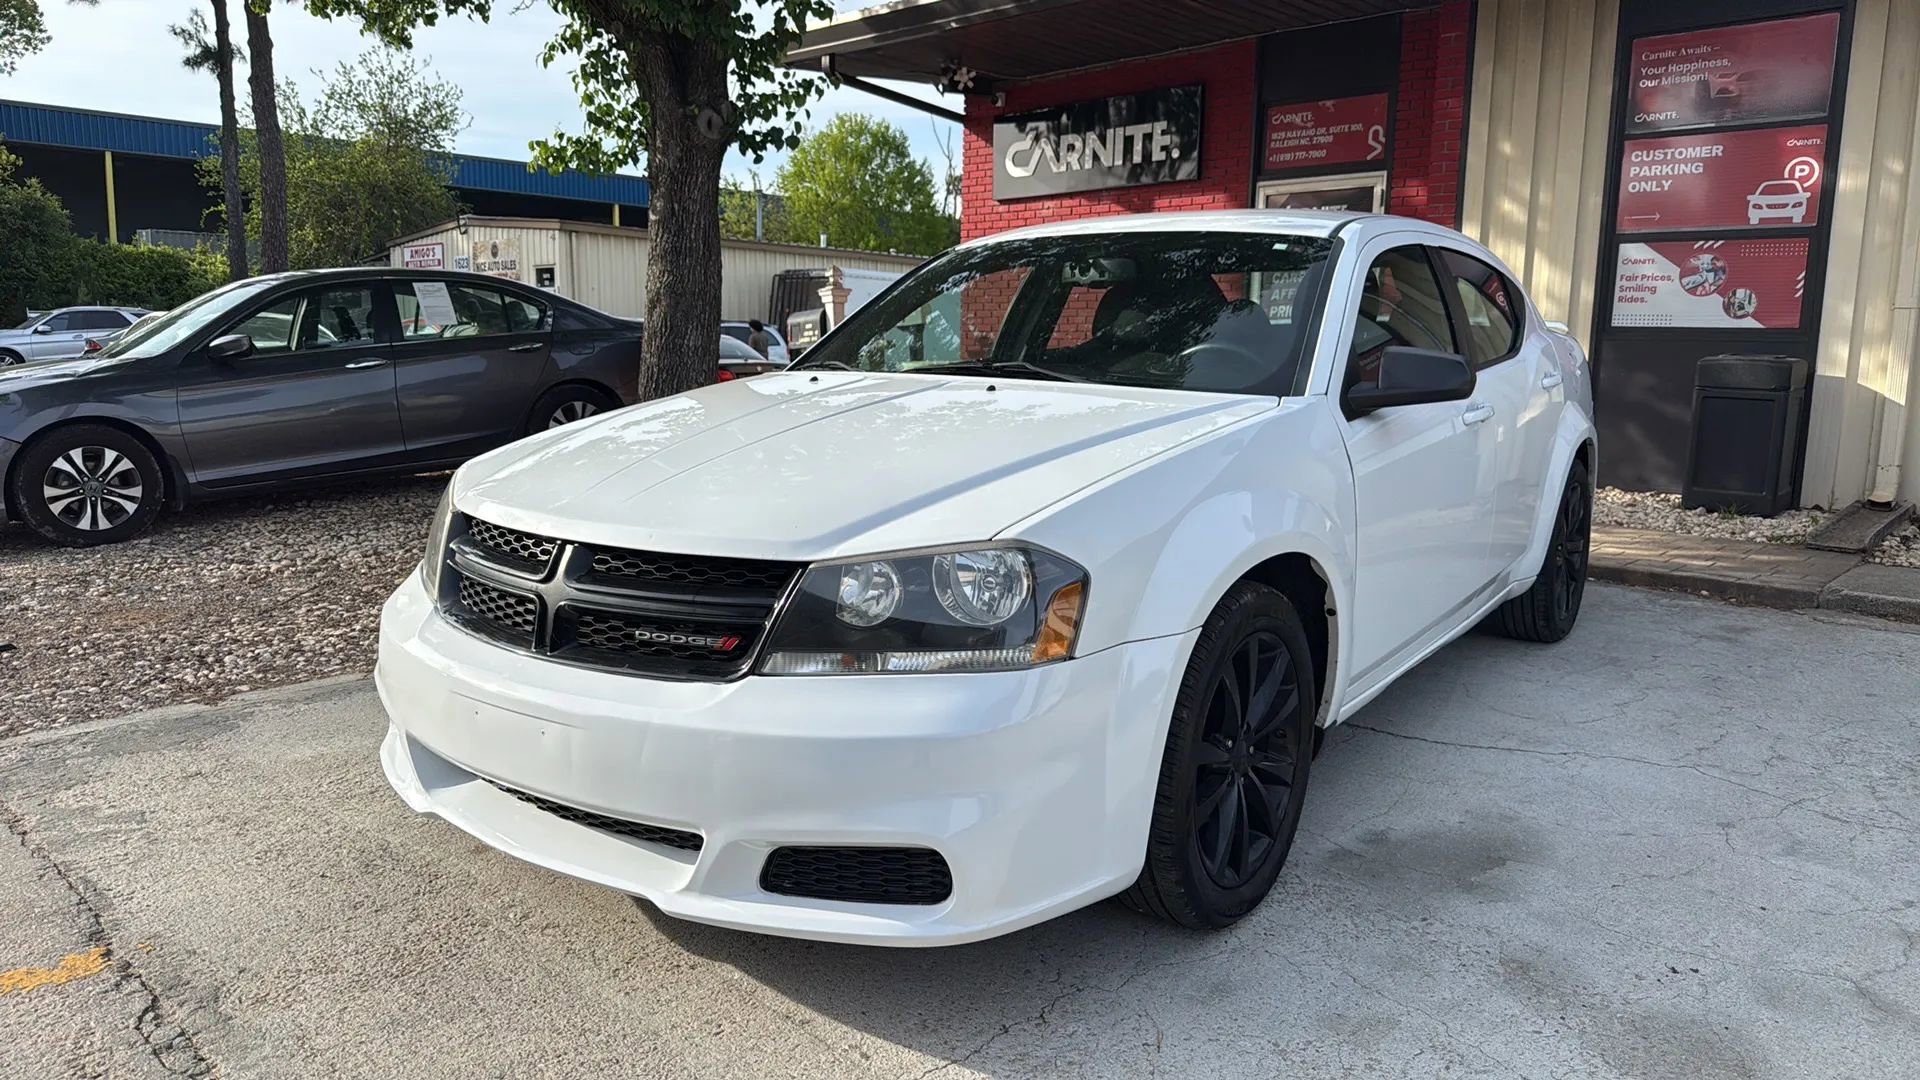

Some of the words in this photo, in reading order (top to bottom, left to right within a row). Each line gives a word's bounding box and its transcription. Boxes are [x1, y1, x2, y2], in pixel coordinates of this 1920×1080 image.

[1641, 50, 1677, 61] Carnite
[1679, 44, 1712, 57] Awaits
[1640, 65, 1666, 76] Your
[1667, 57, 1732, 74] Happiness,
[1639, 79, 1660, 88] Our
[1661, 71, 1709, 86] Mission!
[1329, 124, 1349, 133] SUITE
[1631, 145, 1724, 162] CUSTOMER
[1629, 162, 1704, 177] PARKING
[1627, 179, 1673, 193] ONLY
[410, 247, 436, 259] AMIGO'S
[454, 257, 469, 269] 1623
[488, 261, 500, 271] AUTO
[501, 259, 517, 271] SALES
[1620, 274, 1640, 282] Fair
[1641, 273, 1674, 282] Prices,
[1619, 284, 1657, 295] Smiling
[1617, 295, 1648, 303] Rides.
[635, 630, 722, 646] DODGE
